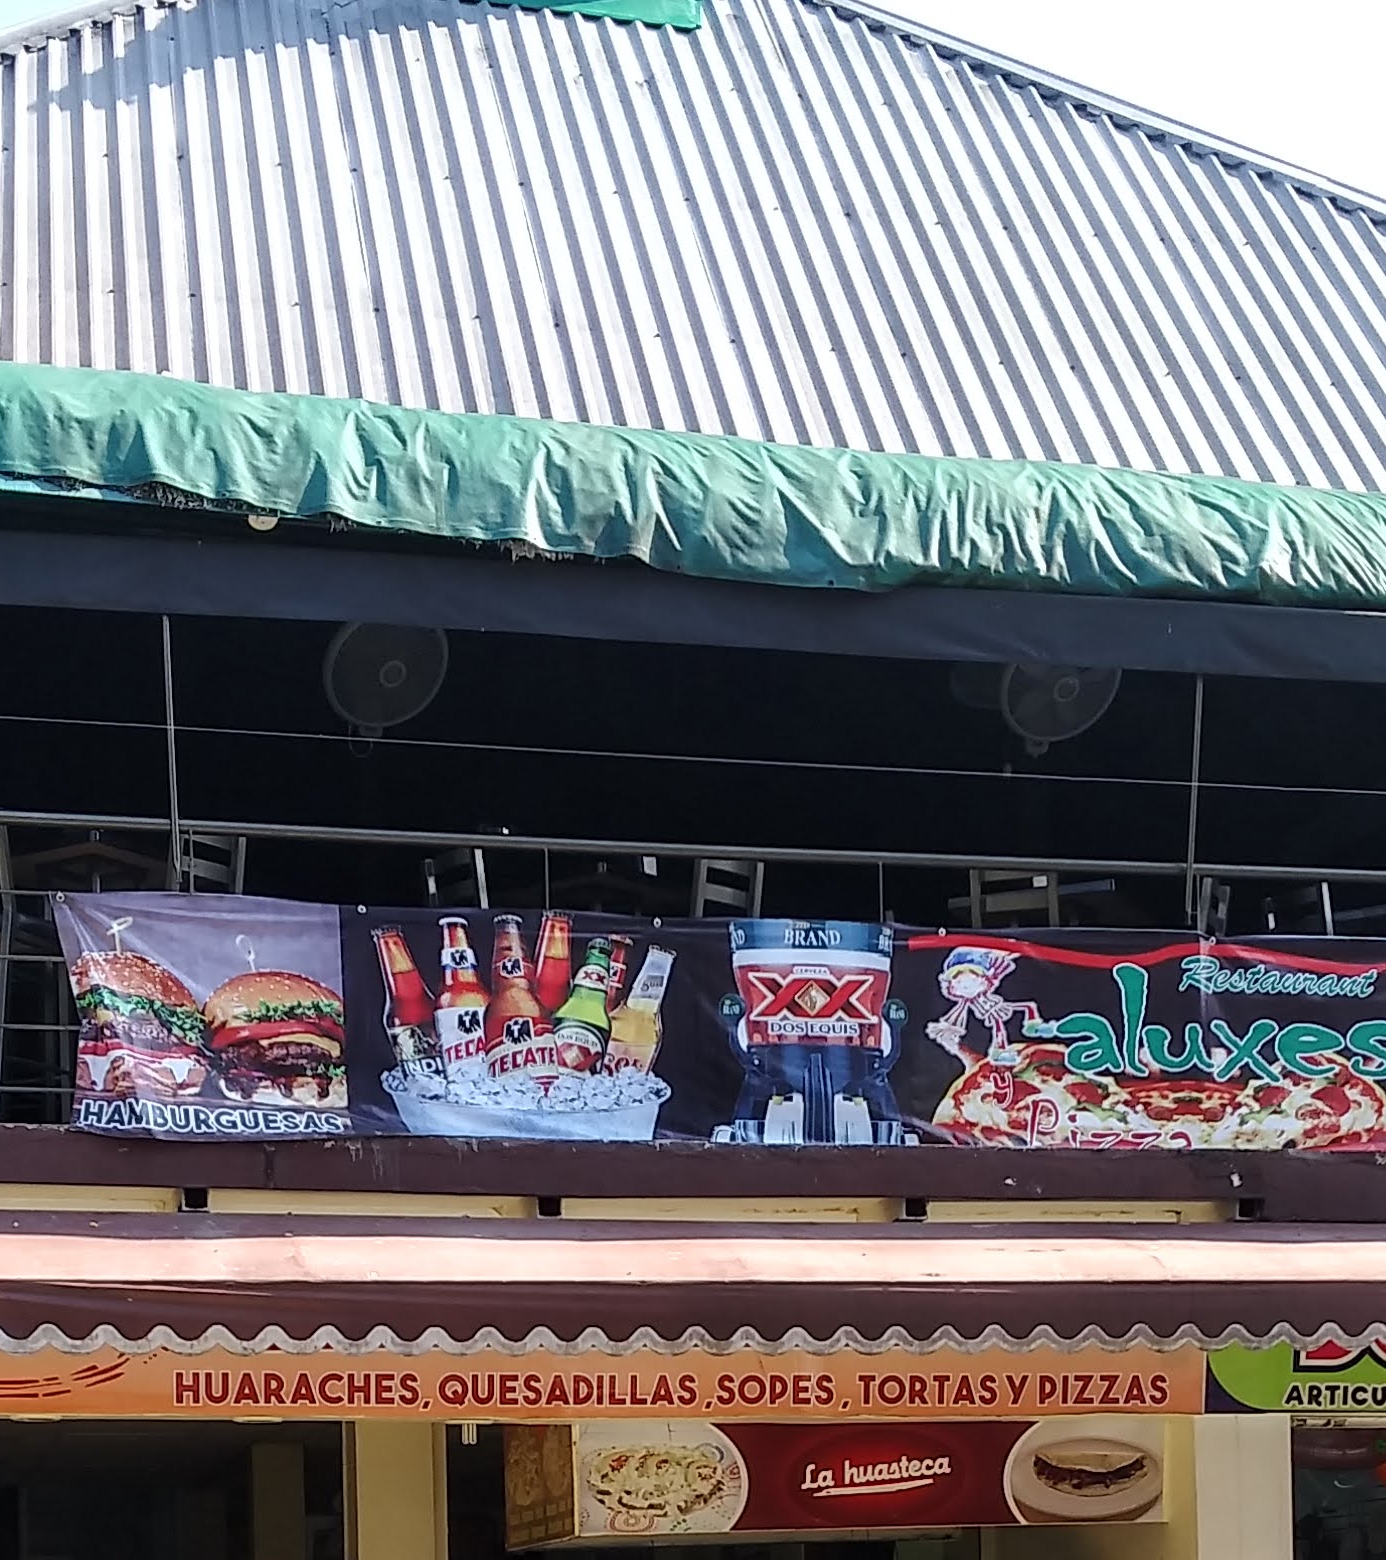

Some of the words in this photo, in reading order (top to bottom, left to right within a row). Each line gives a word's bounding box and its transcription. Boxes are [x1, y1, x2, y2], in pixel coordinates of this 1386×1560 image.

[783, 929, 841, 946] BRAND
[1178, 955, 1378, 999] Restaurant
[771, 1022, 804, 1034] DOS
[809, 1023, 858, 1035] EQUIS
[489, 1046, 555, 1076] TECATE
[991, 1071, 1013, 1108] y
[77, 1099, 344, 1135] HAMBURGUESAS
[174, 1370, 432, 1411] HUARACHES,
[859, 1372, 1005, 1408] TORTAS
[1006, 1372, 1026, 1407] Y
[1036, 1371, 1169, 1407] PIZZAS
[801, 1463, 836, 1491] La
[843, 1454, 951, 1485] huasteca
